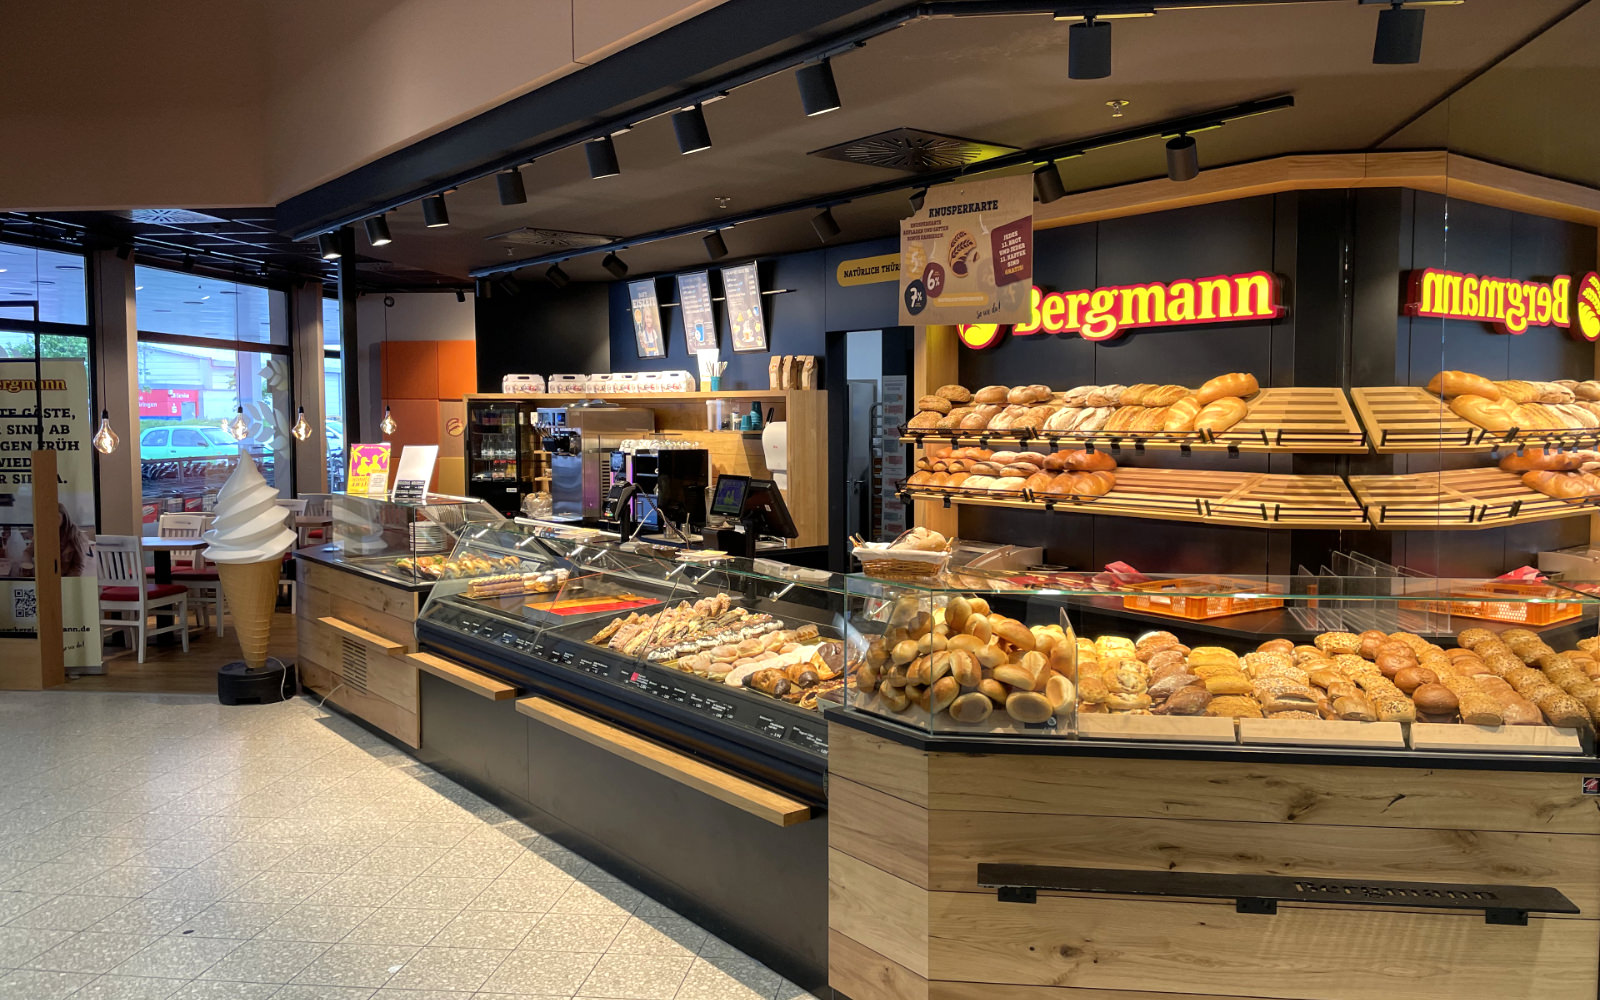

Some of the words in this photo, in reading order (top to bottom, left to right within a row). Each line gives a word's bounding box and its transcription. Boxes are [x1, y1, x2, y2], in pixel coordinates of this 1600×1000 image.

[928, 200, 999, 218] KNUSPERKARTE
[843, 266, 880, 278] NATÜRLICH
[49, 424, 70, 435] AB
[1295, 881, 1498, 899] Bergmann
